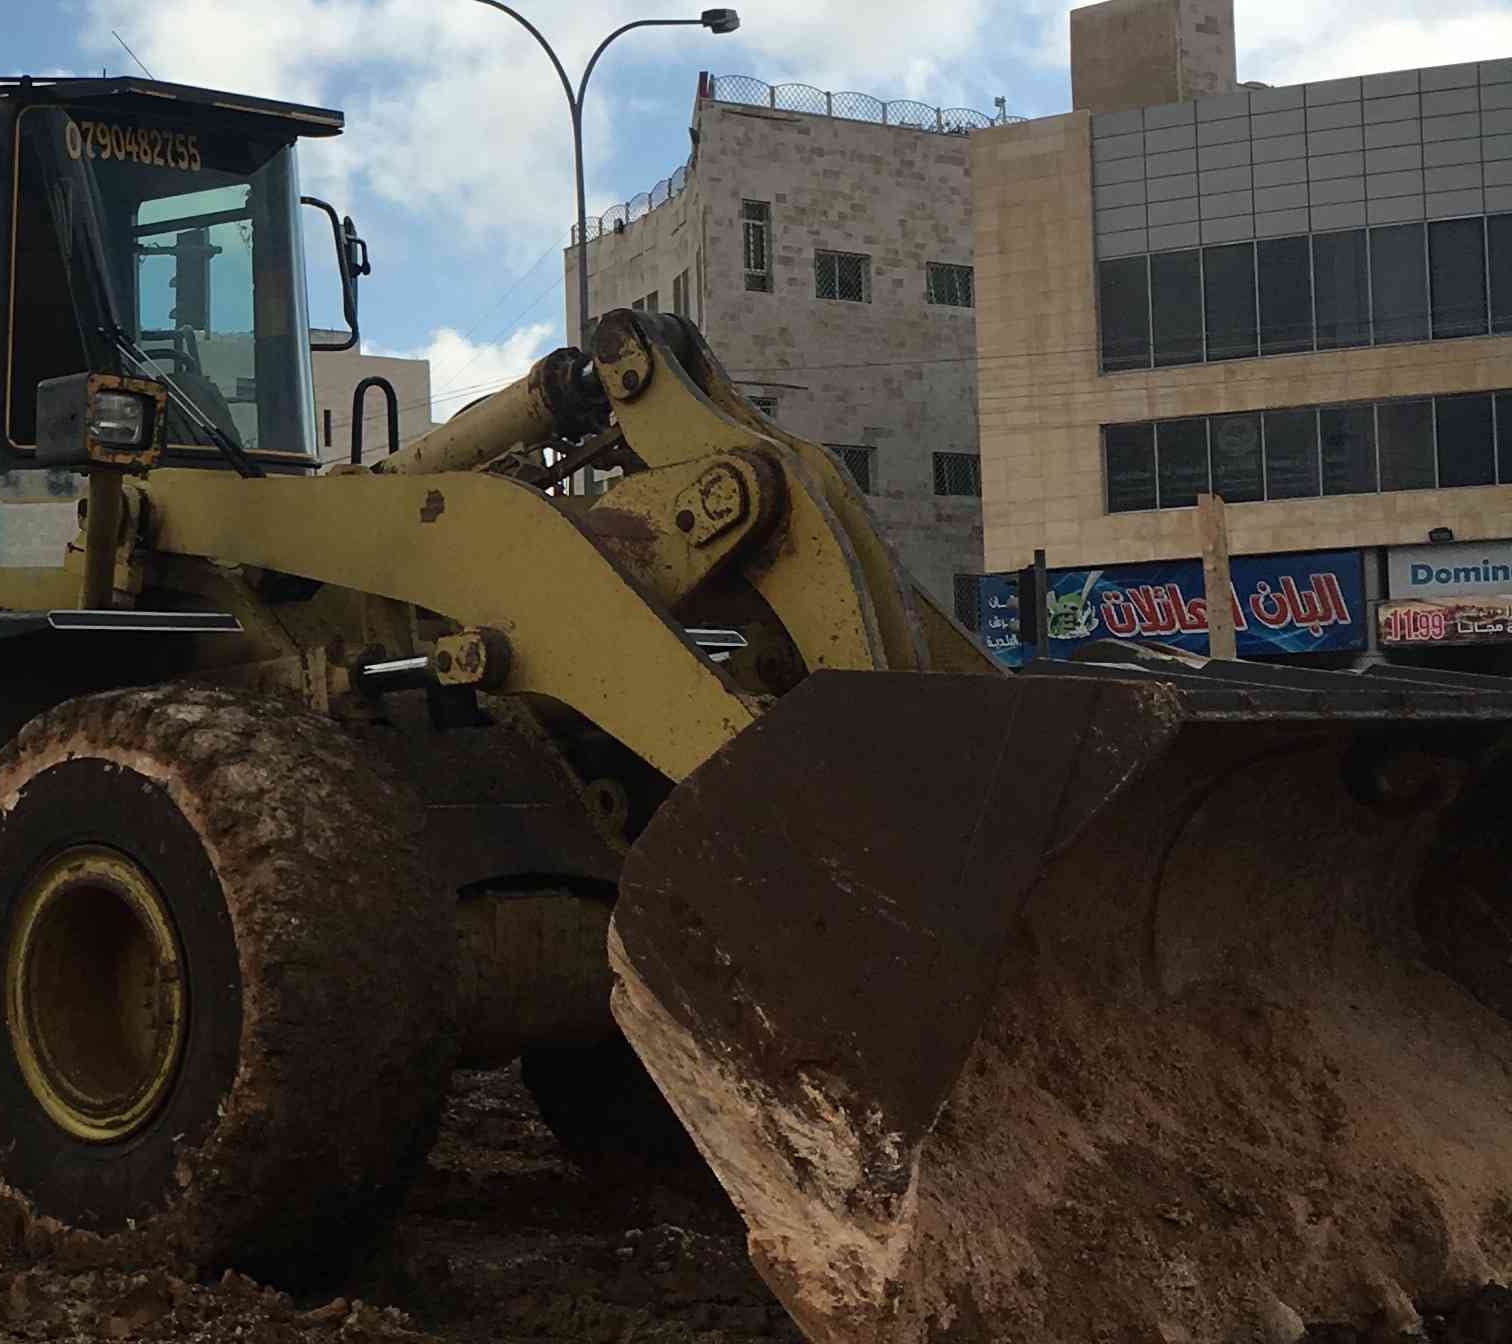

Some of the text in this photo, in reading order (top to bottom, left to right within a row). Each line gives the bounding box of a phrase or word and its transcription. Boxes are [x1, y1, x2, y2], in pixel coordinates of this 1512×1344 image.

[64, 119, 201, 172] 0790482755
[1410, 558, 1512, 586] Domin
[1248, 572, 1352, 638] البان
